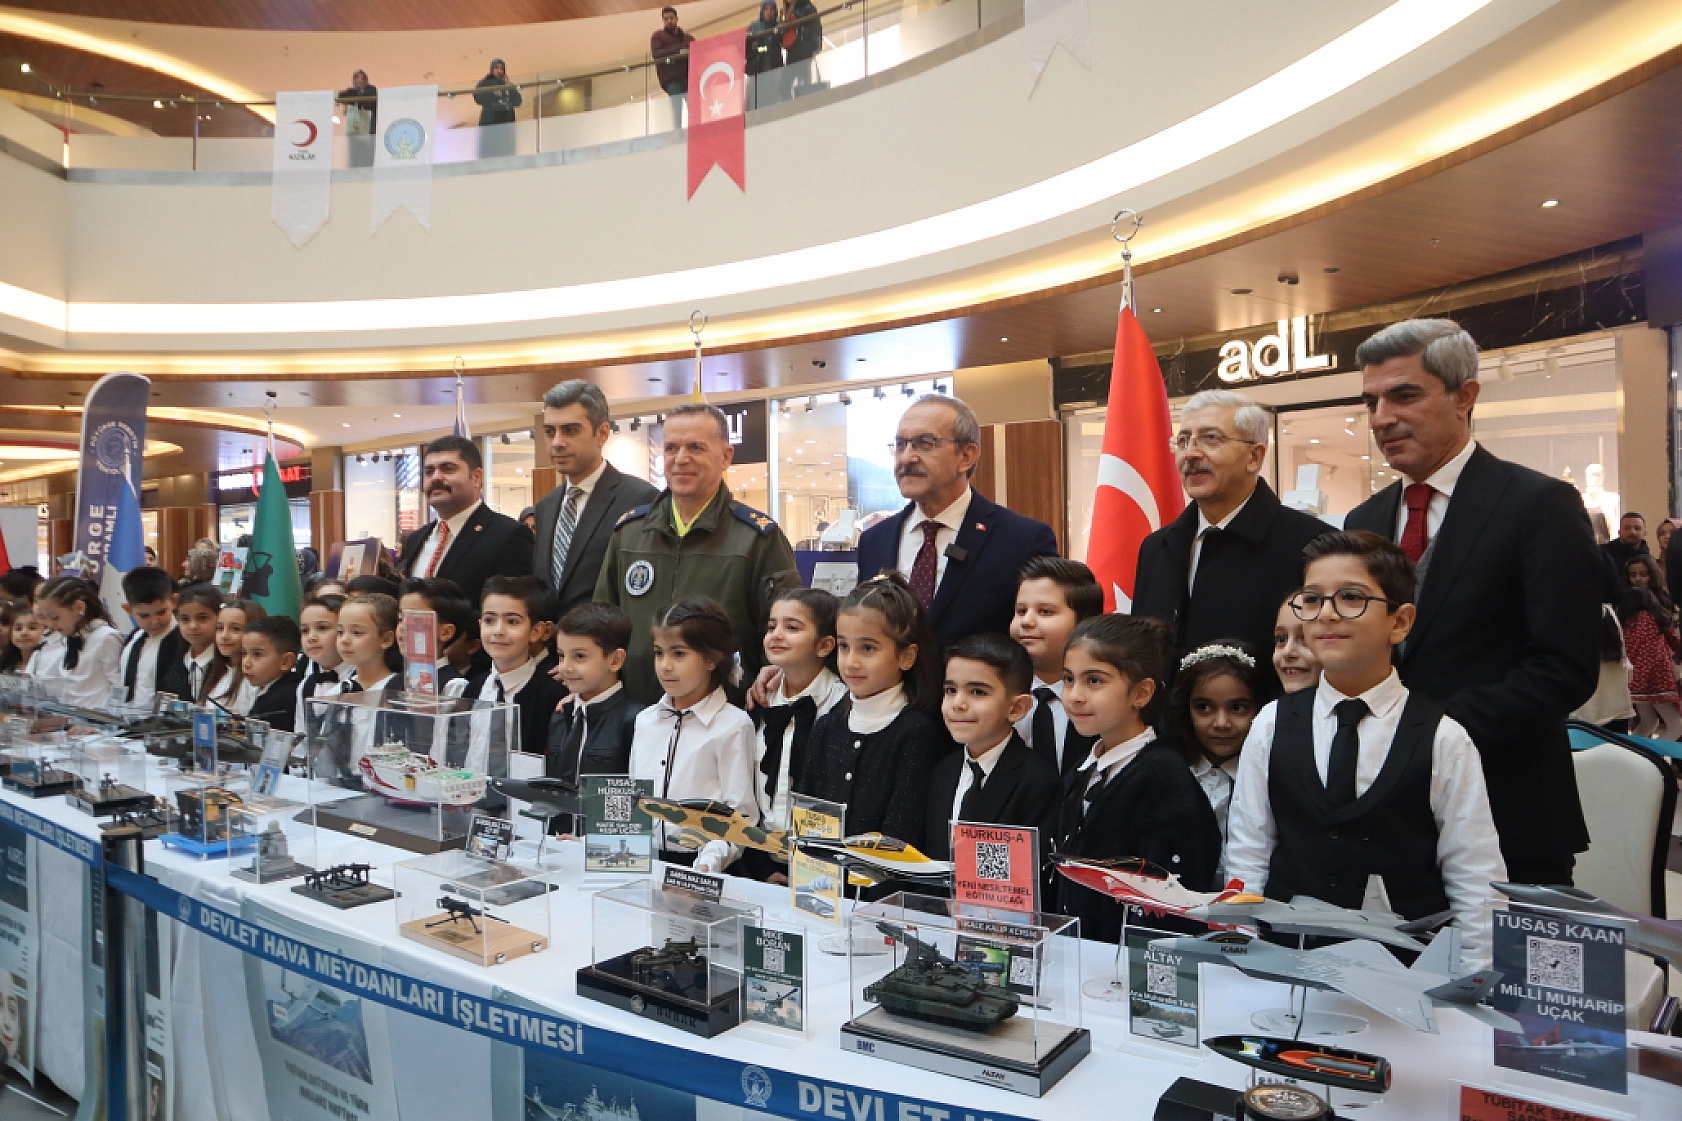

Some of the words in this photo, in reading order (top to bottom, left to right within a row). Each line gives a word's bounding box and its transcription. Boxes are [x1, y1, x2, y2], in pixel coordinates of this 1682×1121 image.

[960, 827, 1024, 843] HÜRKUŞ-A
[1495, 913, 1560, 939] TUSAŞ
[1565, 924, 1624, 945] KAAN
[1143, 950, 1183, 966] ALTAY
[200, 906, 260, 948] DEVLET
[262, 932, 310, 969] HAVA
[314, 952, 444, 1015] MEYDANLARI
[452, 990, 585, 1055] İŞLETMESİ
[1500, 983, 1542, 1001] MİLLİ
[1545, 991, 1624, 1016] MUHARİP
[1537, 1004, 1585, 1023] UÇAK
[857, 1039, 876, 1053] BMC
